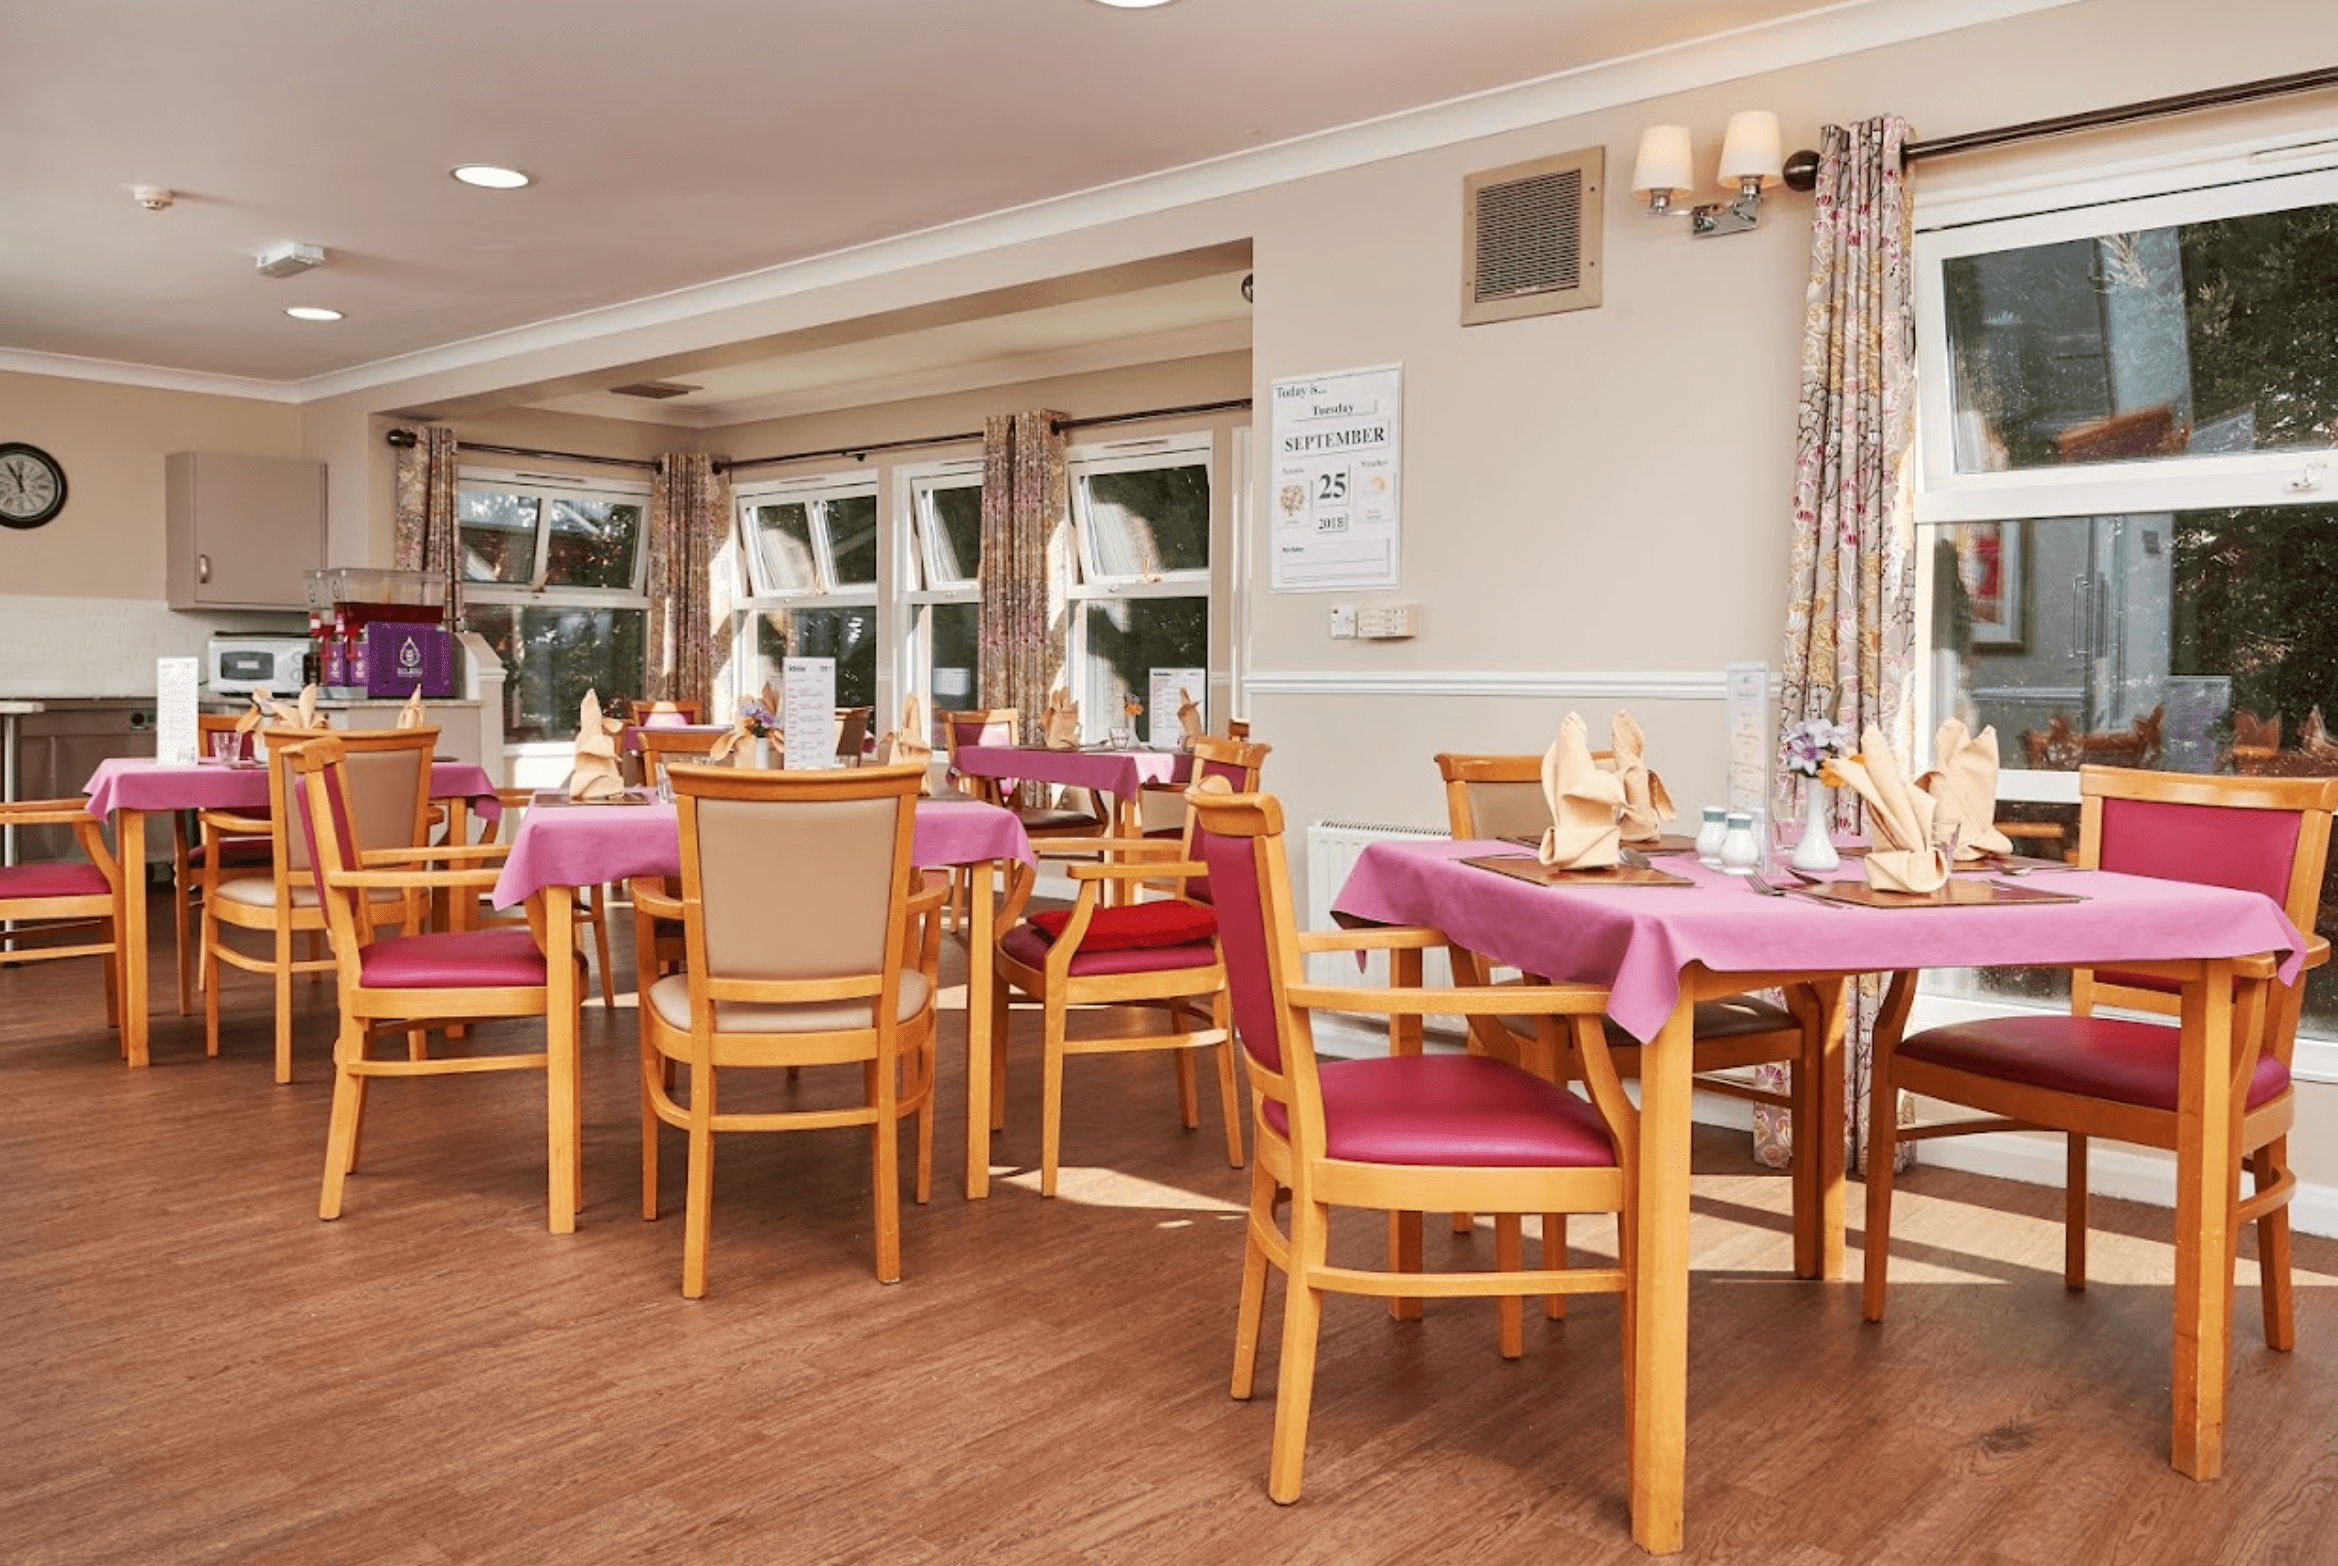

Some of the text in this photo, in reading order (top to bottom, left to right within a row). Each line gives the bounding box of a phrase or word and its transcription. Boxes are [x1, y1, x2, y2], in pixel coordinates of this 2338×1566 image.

[1276, 386, 1307, 399] Today
[1313, 403, 1354, 415] Tuesday
[1284, 427, 1385, 452] SEPTEMBER
[1319, 472, 1346, 499] 25
[1318, 517, 1344, 530] 2018
